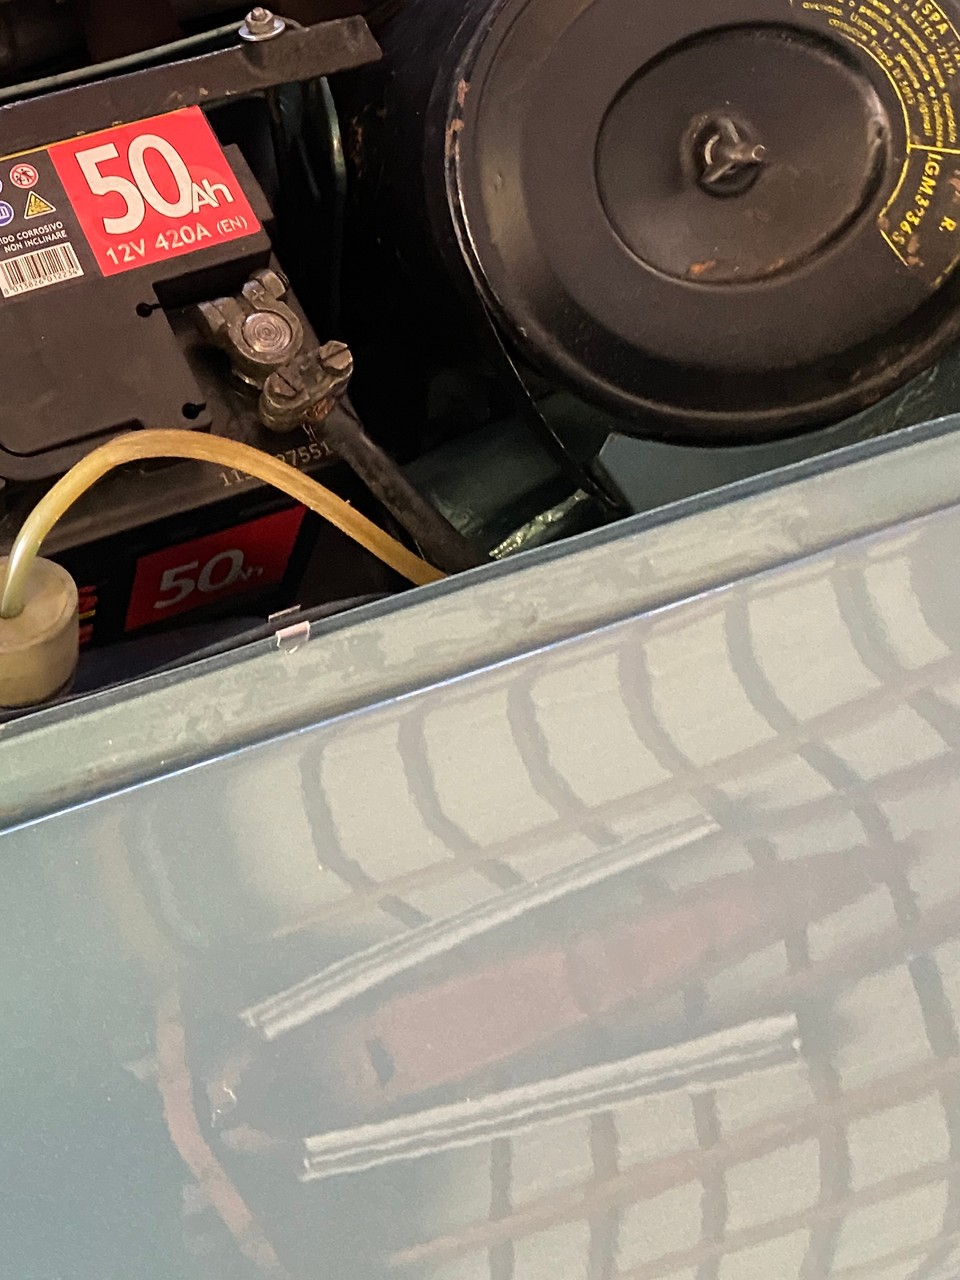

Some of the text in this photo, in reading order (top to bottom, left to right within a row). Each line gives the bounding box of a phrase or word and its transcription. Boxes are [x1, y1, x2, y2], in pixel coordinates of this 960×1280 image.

[75, 134, 234, 234] 50Ah
[4, 229, 68, 254] NON INCLINARE
[16, 221, 64, 241] CORROSIVO
[106, 215, 248, 265] 12V 420A (EN)
